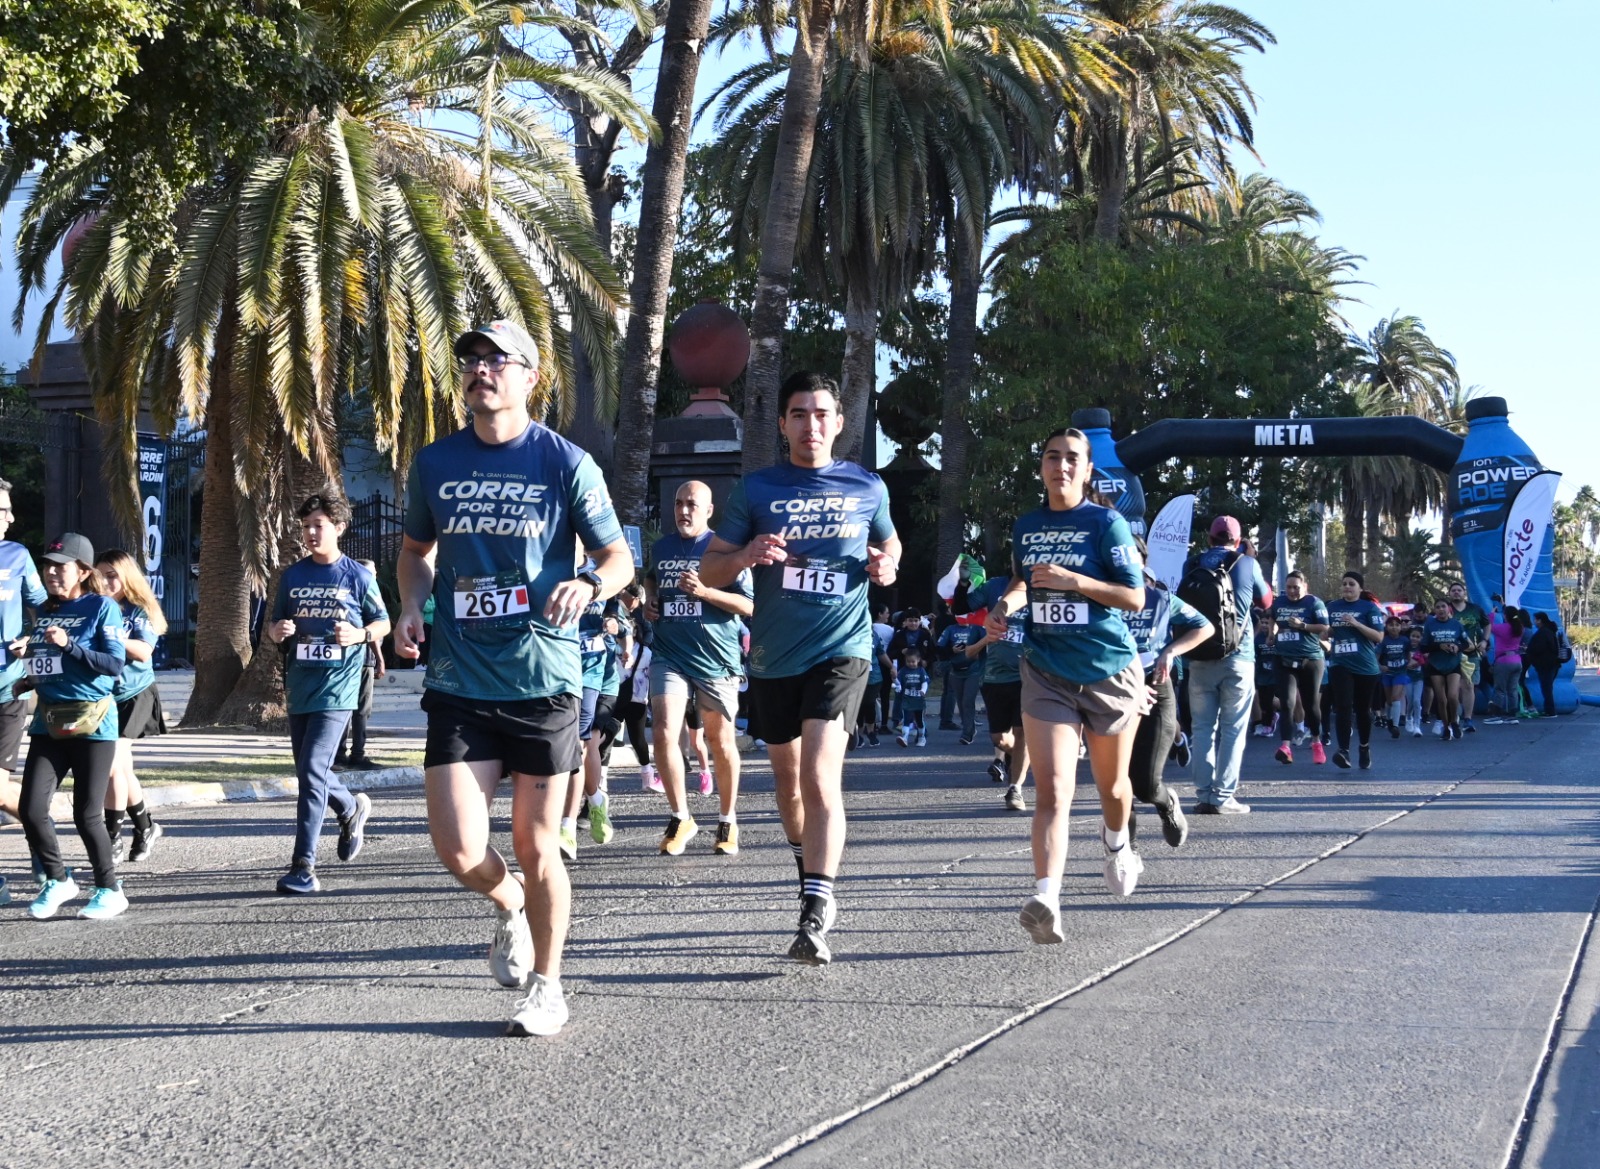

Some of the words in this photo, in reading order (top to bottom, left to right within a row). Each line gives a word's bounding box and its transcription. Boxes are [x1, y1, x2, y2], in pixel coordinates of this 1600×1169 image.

[1255, 425, 1314, 445] META
[438, 480, 549, 504] CORRE
[1459, 482, 1507, 505] ADE
[456, 502, 496, 513] POR
[501, 503, 525, 515] TU
[769, 497, 861, 514] CORRE
[442, 514, 547, 538] JARDÍN
[787, 514, 820, 523] POR
[826, 513, 846, 521] TU
[143, 496, 162, 572] 6
[1021, 531, 1090, 545] CORRE
[1152, 531, 1188, 543] AHOME
[1056, 544, 1073, 552] TU
[658, 560, 700, 570] CORR
[795, 569, 836, 593] 115
[289, 587, 352, 599] CORRE
[465, 589, 513, 617] 267
[669, 602, 695, 616] 308
[1039, 603, 1077, 623] 186
[303, 645, 333, 659] 146
[28, 658, 54, 674] 198
